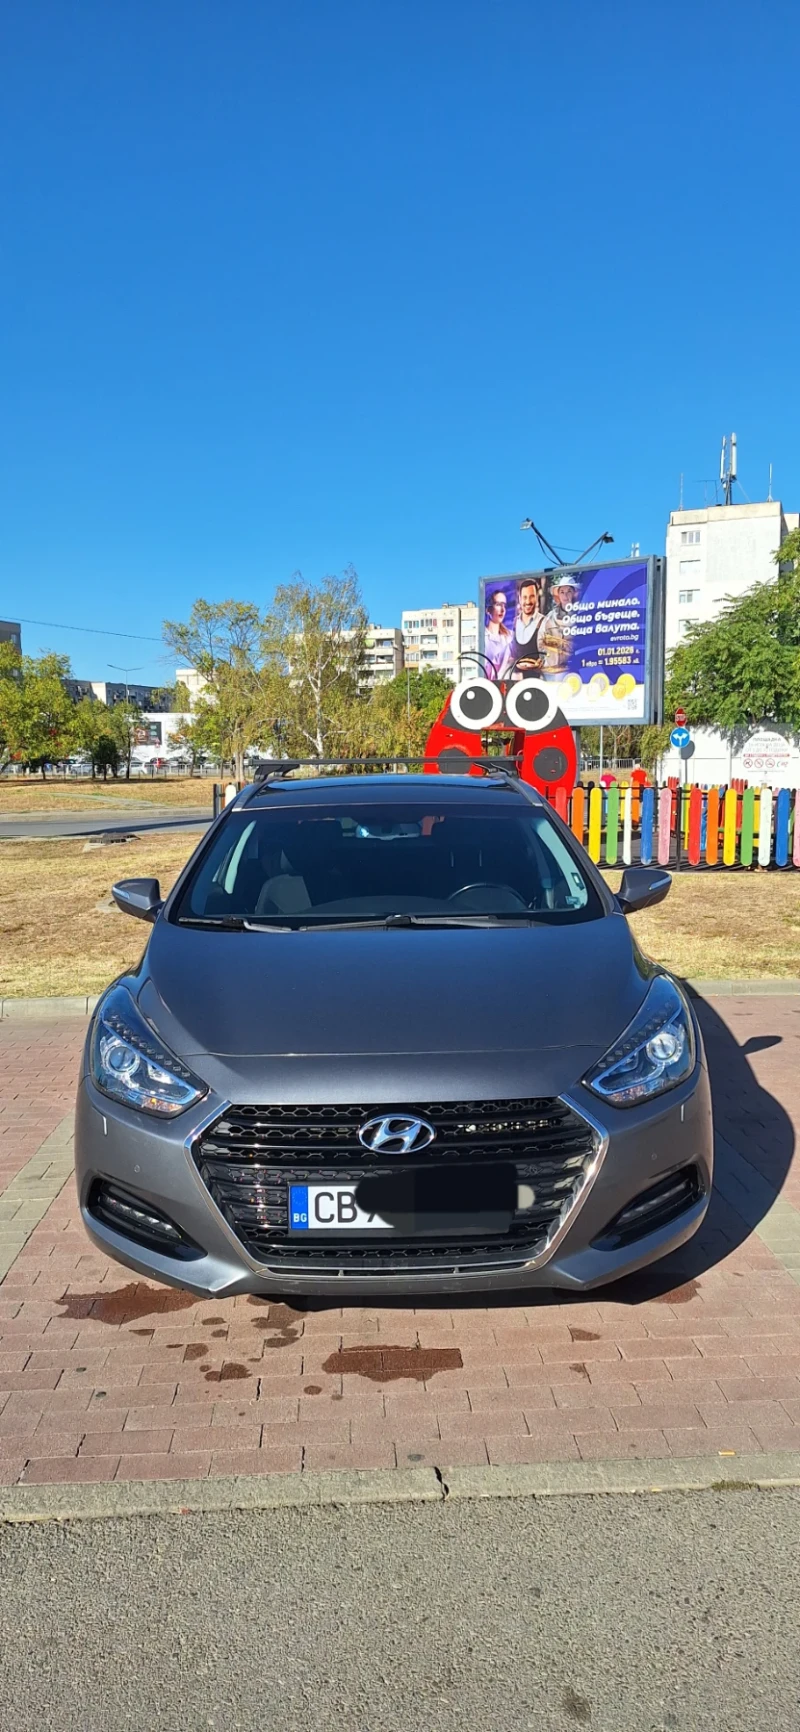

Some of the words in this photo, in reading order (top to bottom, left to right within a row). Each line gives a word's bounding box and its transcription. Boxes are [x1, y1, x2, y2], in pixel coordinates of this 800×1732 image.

[564, 601, 595, 612] Общо
[597, 597, 640, 609] минало.
[562, 614, 593, 624] Общо
[595, 610, 640, 622] бъдеще.
[562, 626, 593, 636] Обща
[595, 622, 640, 634] валута.
[293, 1212, 307, 1223] BG
